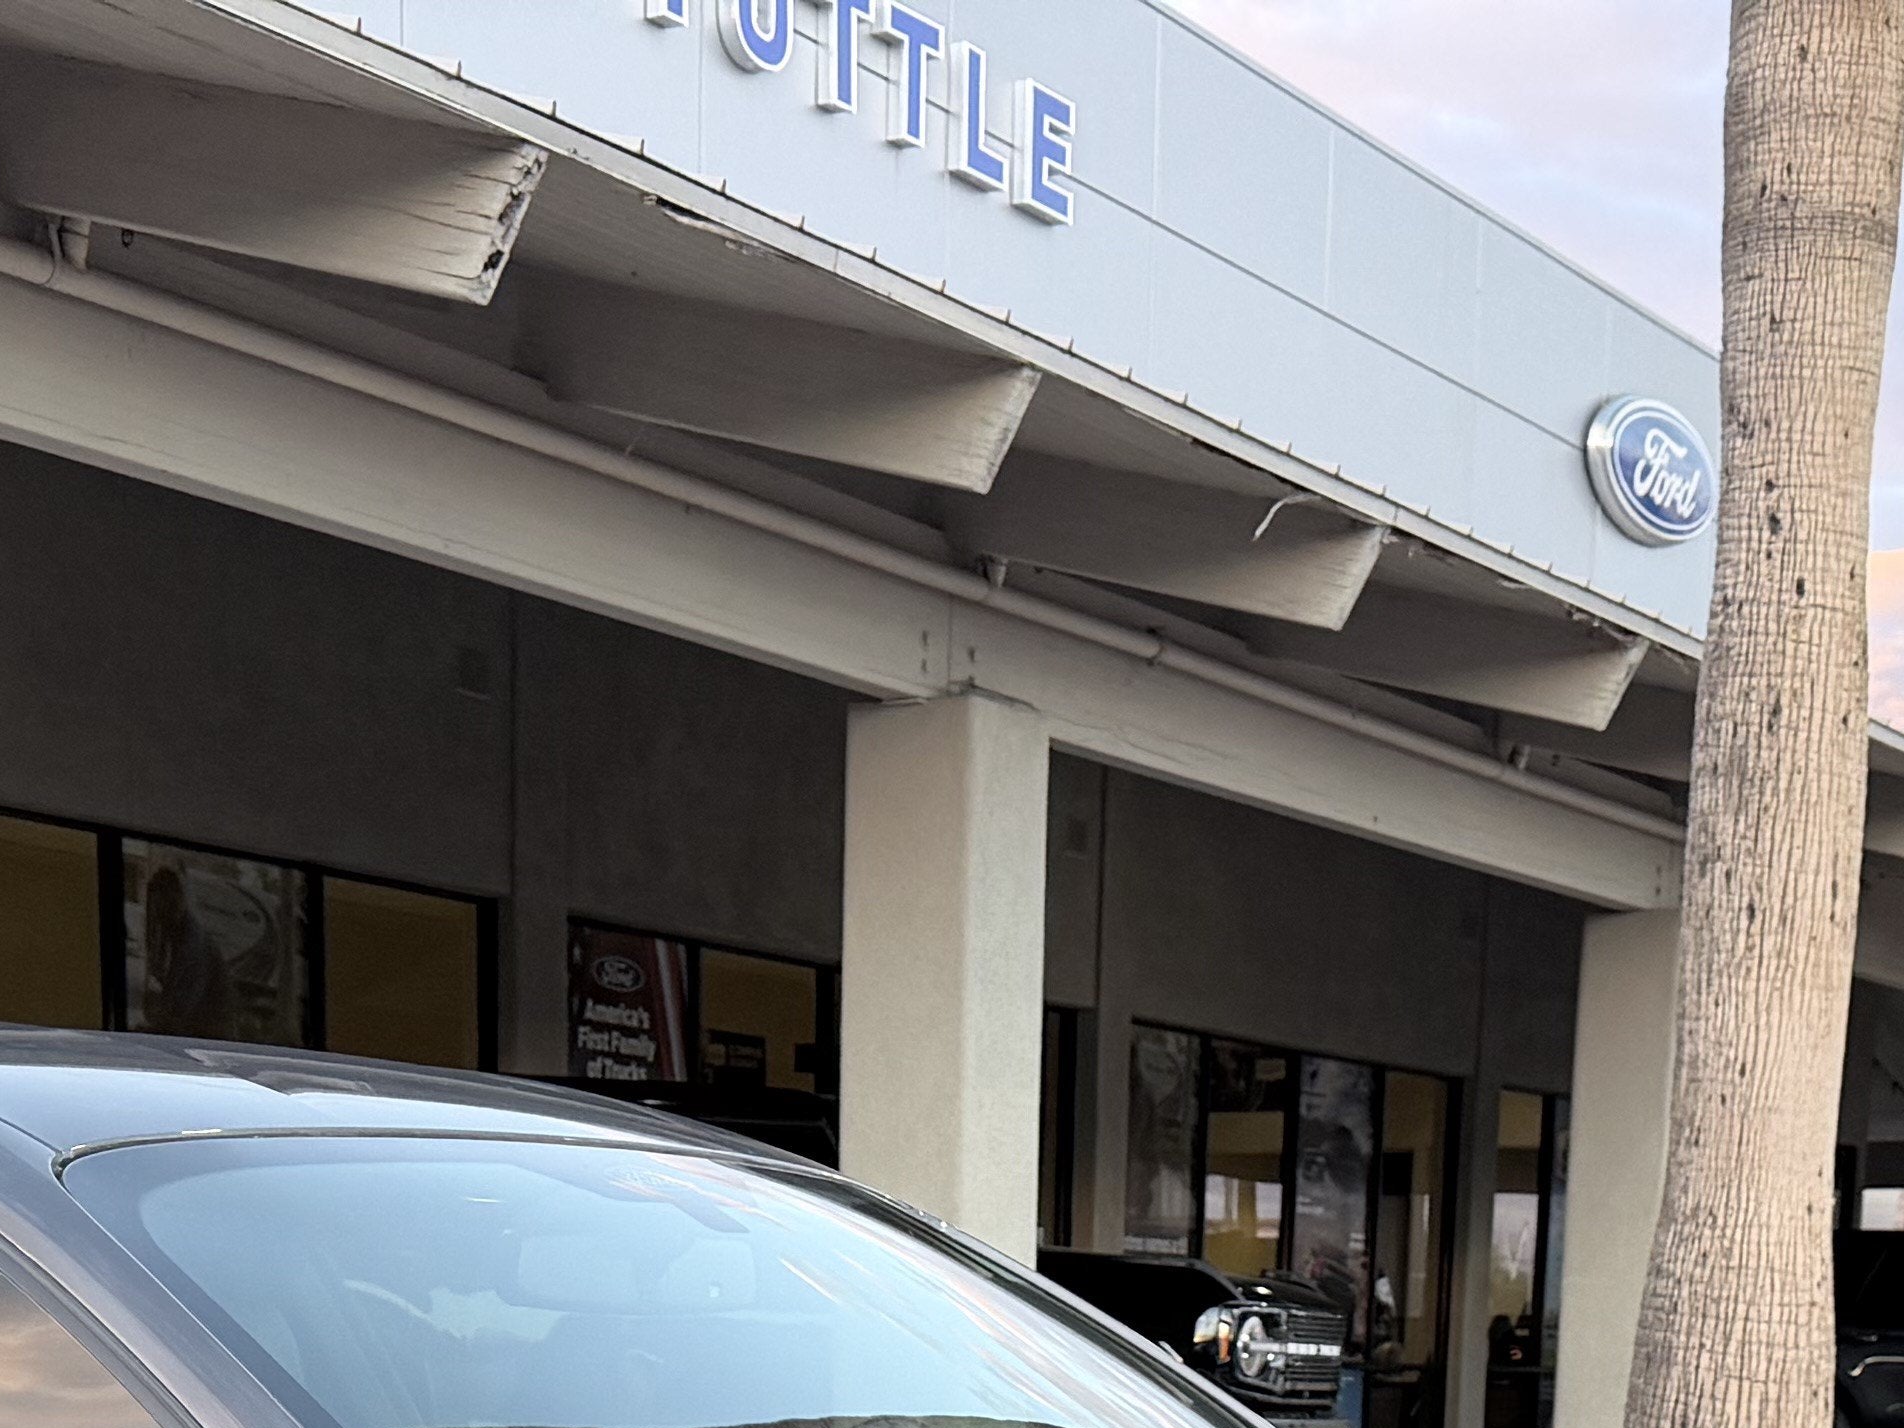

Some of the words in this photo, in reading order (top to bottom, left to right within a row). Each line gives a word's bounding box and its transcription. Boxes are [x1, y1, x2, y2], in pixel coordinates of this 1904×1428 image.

[646, 0, 1076, 226] UTTLE
[584, 998, 650, 1029] America's
[577, 1025, 610, 1051] First
[611, 1030, 657, 1062] Family
